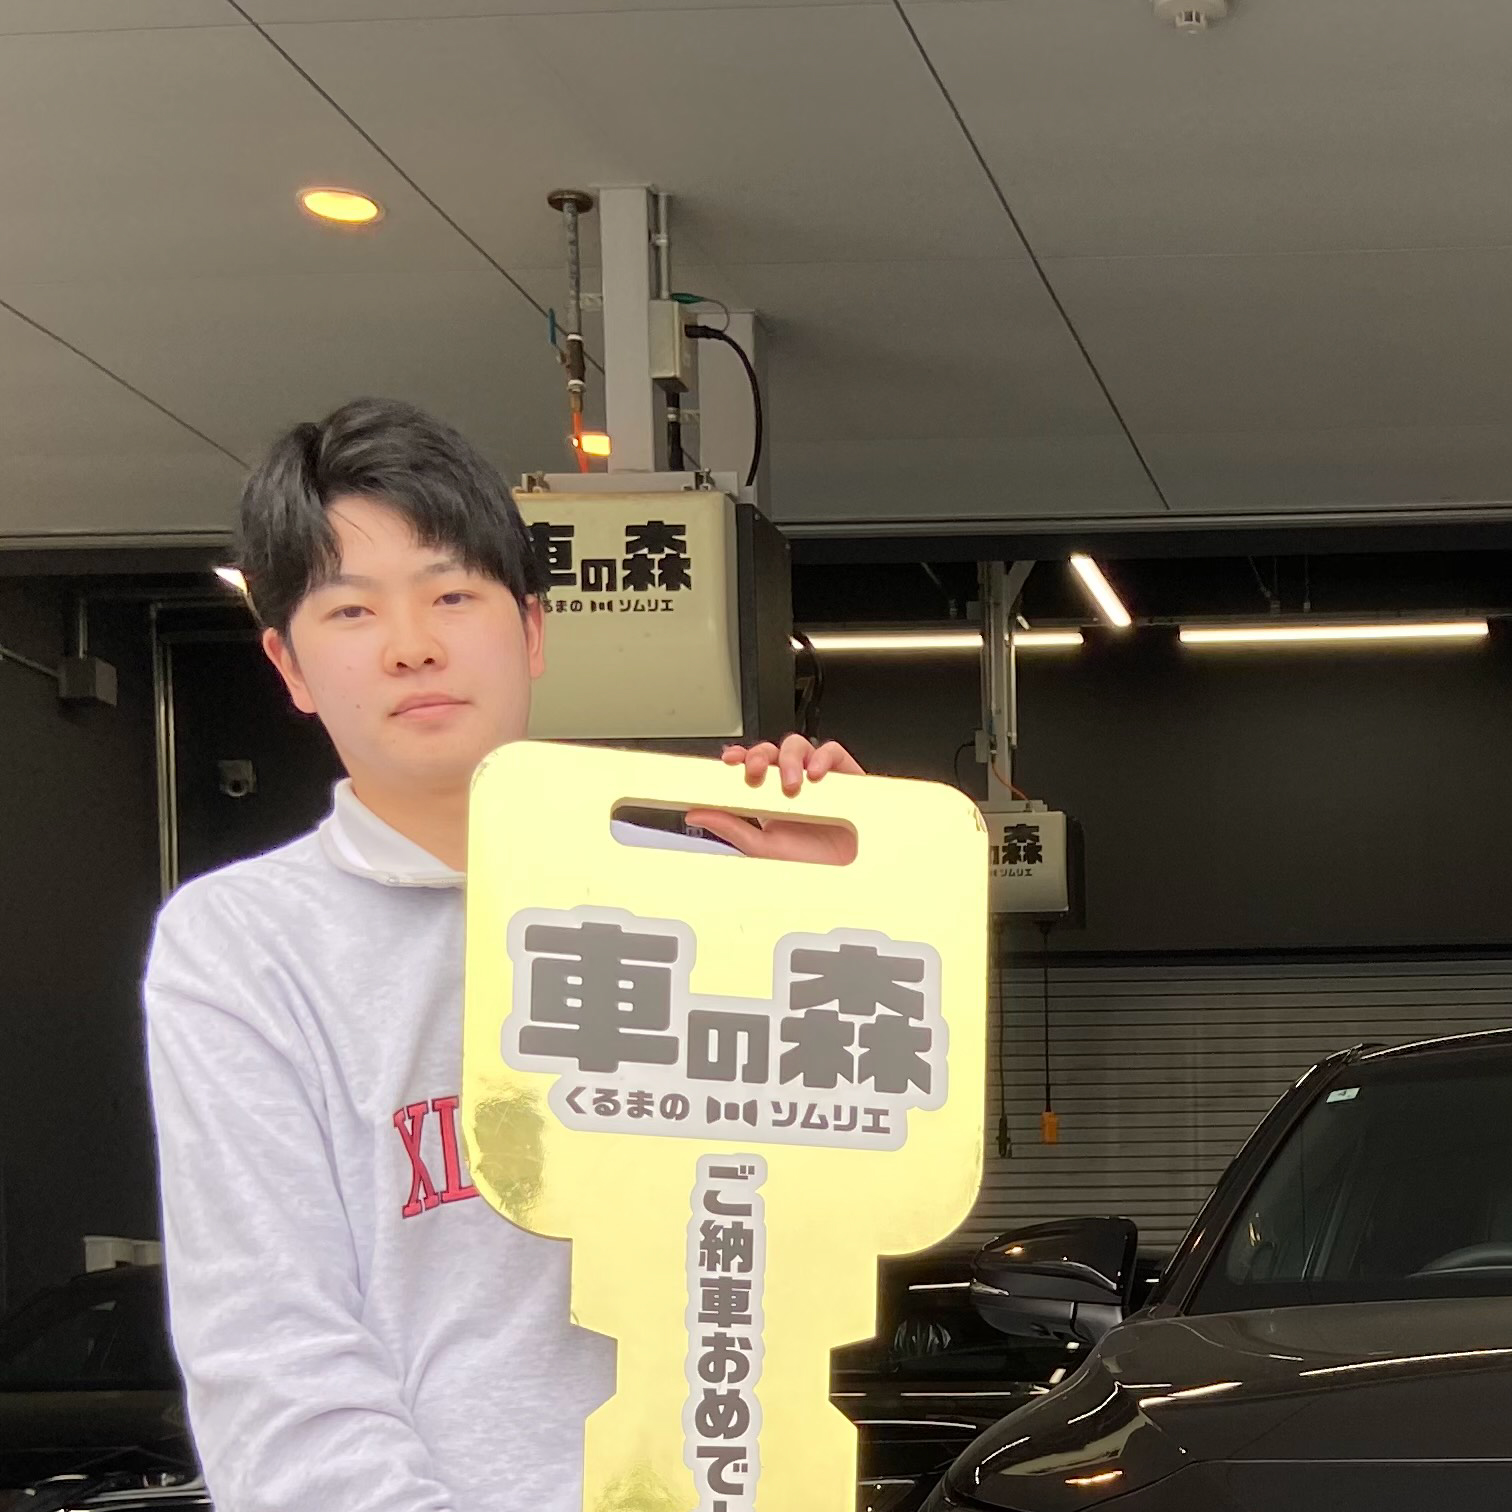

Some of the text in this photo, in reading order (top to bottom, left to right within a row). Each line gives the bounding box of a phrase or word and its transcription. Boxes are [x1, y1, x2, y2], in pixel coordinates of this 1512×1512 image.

[619, 599, 674, 612] ソムリエ
[518, 922, 932, 1095] 車の森
[566, 1086, 892, 1135] くるまの ソムリエ
